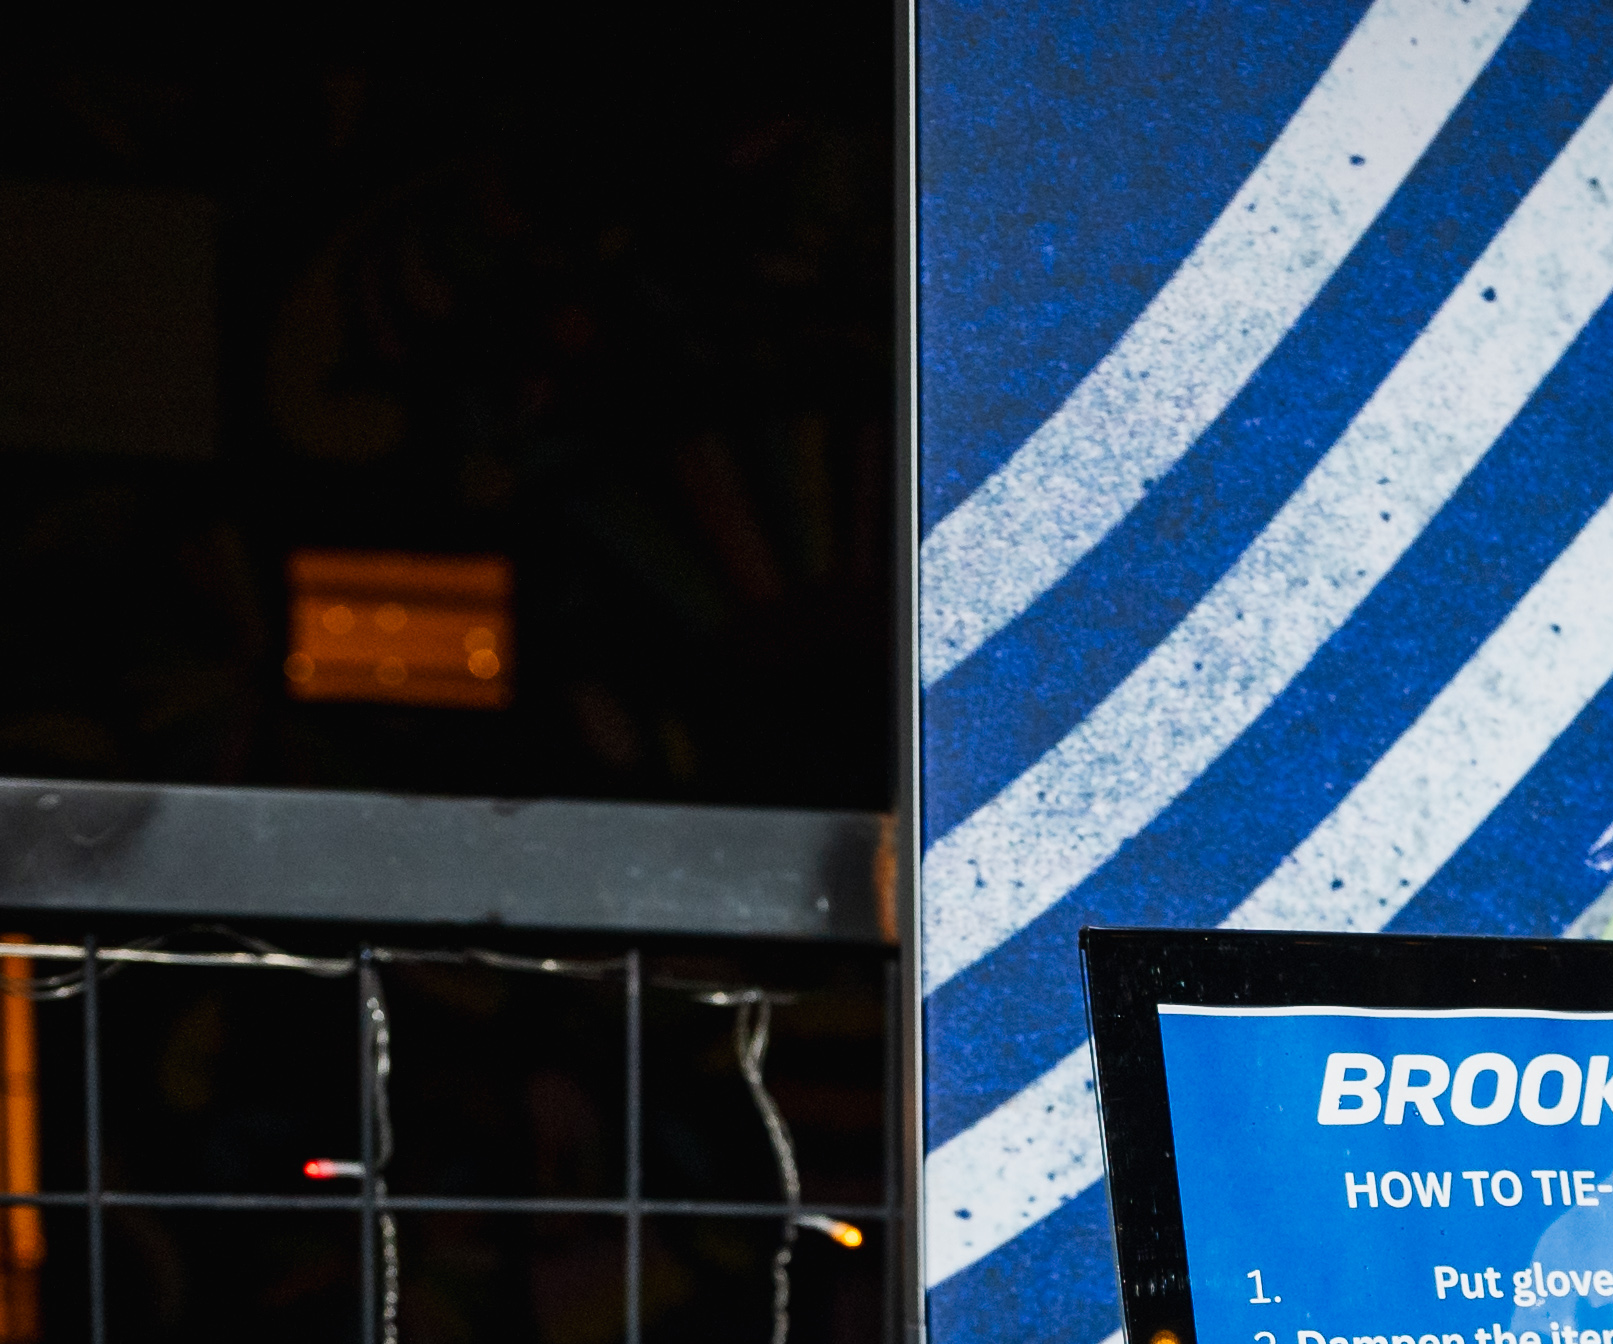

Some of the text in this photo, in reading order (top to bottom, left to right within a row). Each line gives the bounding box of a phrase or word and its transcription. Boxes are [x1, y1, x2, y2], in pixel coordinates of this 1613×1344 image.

[1345, 1171, 1451, 1208] HOW
[1462, 1170, 1522, 1206] TO
[1248, 1270, 1281, 1303] 1.
[1434, 1266, 1504, 1299] Put
